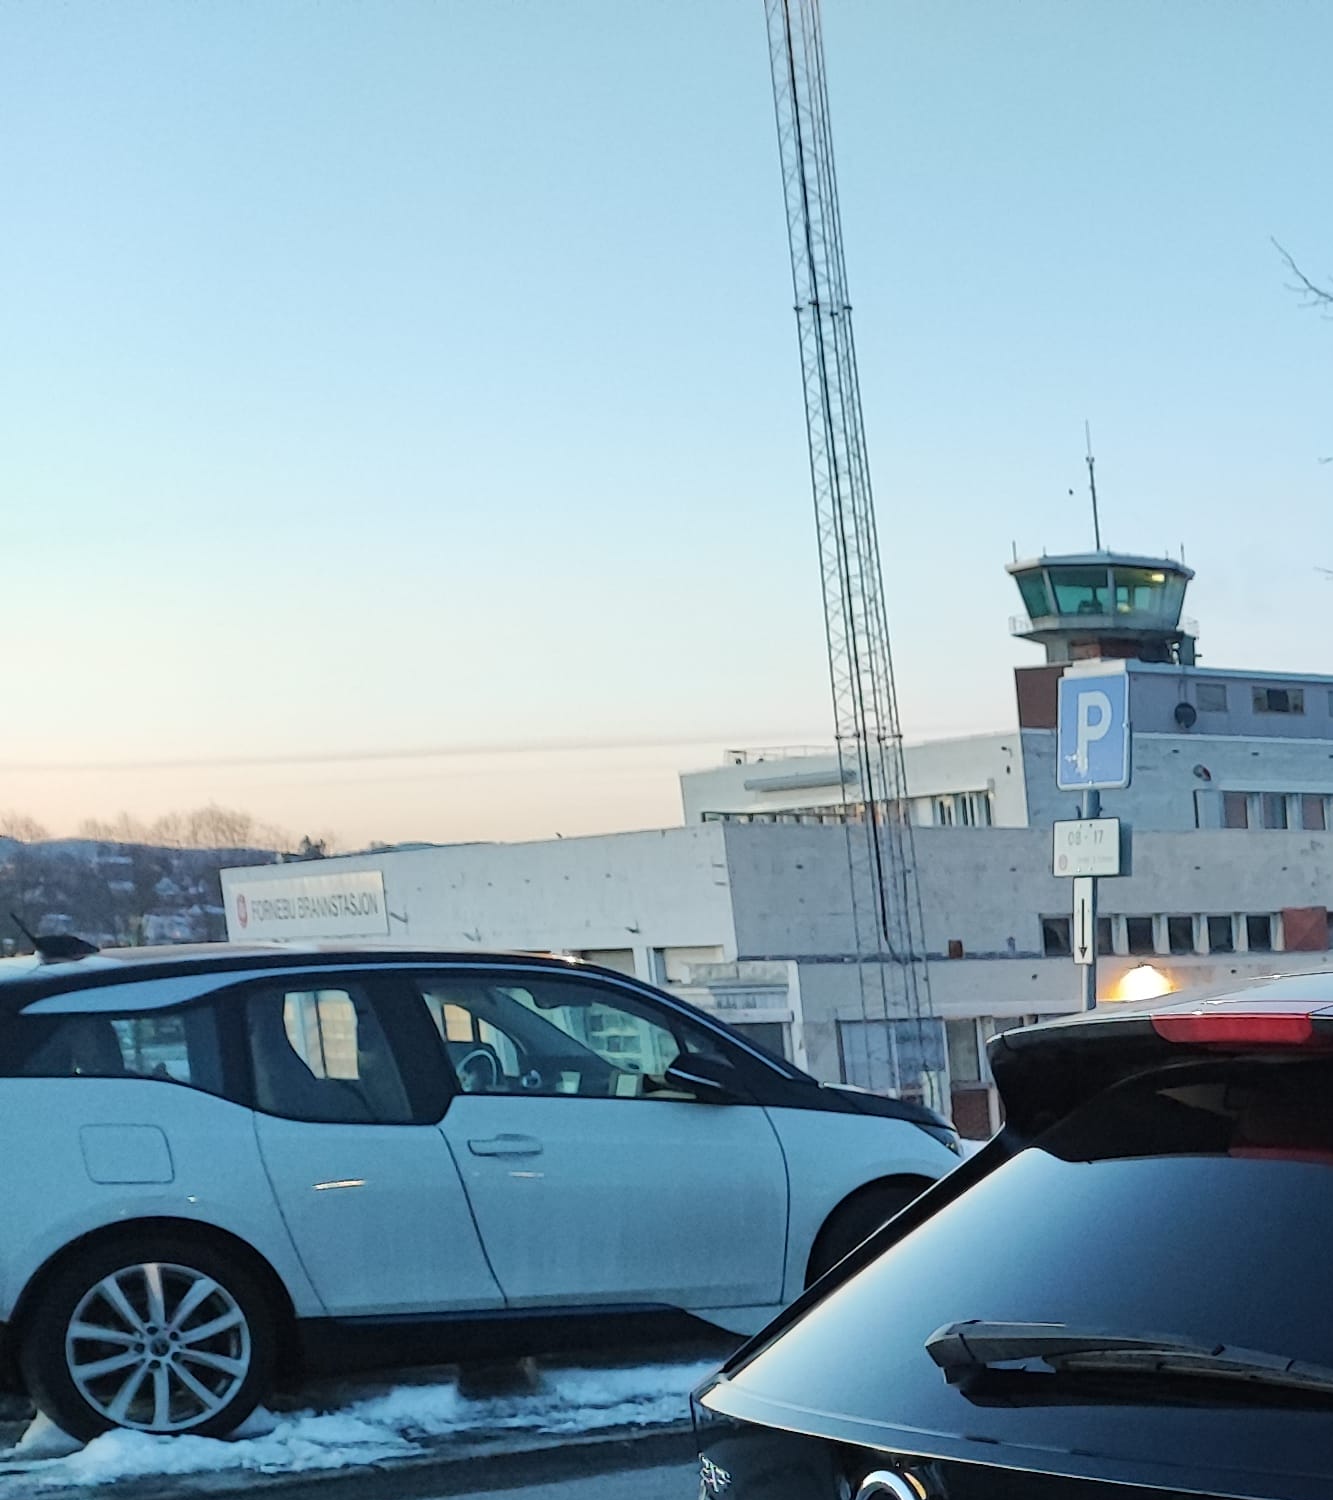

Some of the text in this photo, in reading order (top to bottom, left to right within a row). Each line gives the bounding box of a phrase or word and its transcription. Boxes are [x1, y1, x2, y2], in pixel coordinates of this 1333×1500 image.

[1077, 690, 1113, 777] P
[251, 892, 379, 921] FORNEBU BRANNSTASJON
